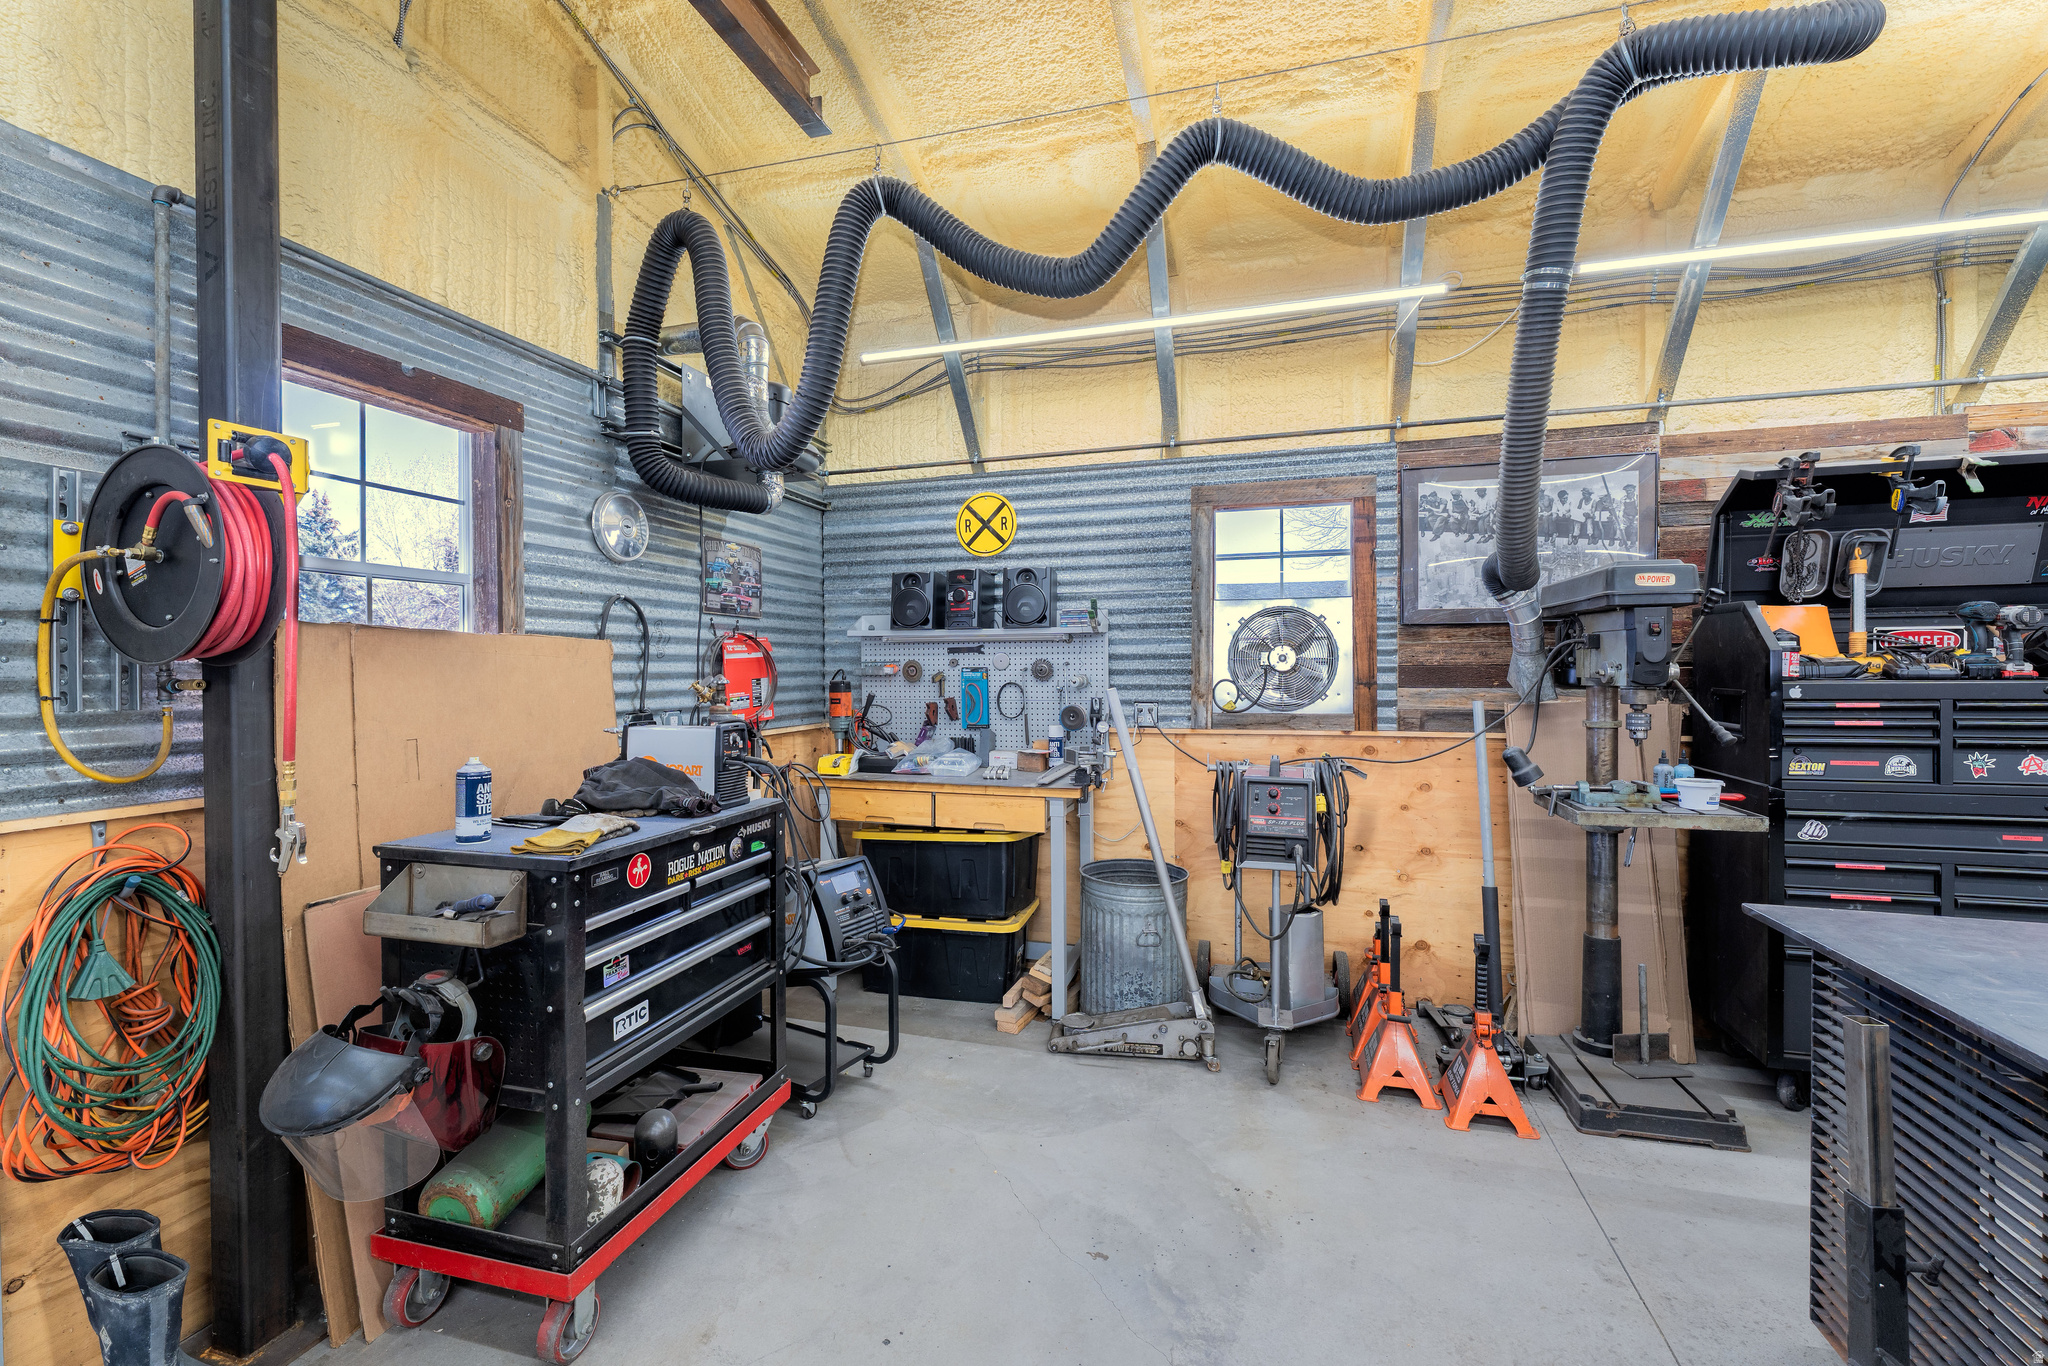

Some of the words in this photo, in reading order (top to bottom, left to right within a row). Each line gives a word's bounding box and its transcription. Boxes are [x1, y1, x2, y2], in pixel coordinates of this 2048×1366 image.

[202, 80, 217, 142] INC.
[203, 163, 218, 230] VEST
[965, 518, 972, 533] R
[1001, 516, 1008, 531] R
[1886, 544, 2015, 569] HUSKY
[1646, 575, 1671, 583] POWER
[662, 763, 704, 777] OBART
[1788, 762, 1826, 771] SEXTON
[746, 819, 772, 836] HUSKY
[667, 854, 695, 877] ROGUE
[697, 844, 726, 867] NATION
[667, 872, 685, 886] DARE
[687, 865, 703, 878] RISK
[705, 858, 726, 871] DREAM
[615, 1006, 648, 1036] RTIC
